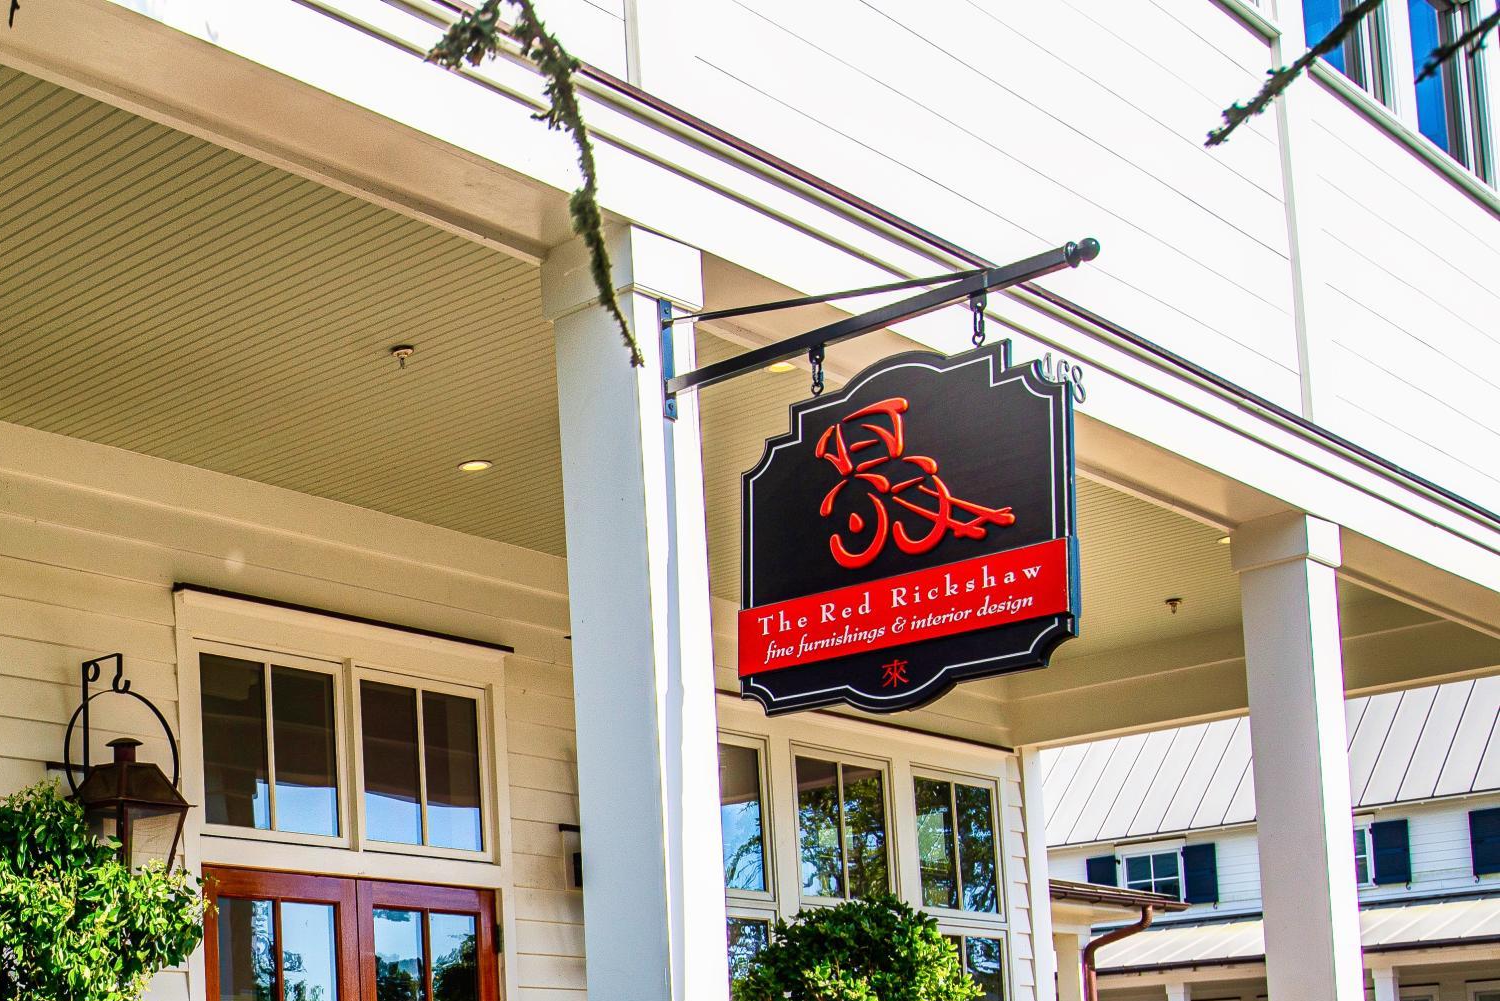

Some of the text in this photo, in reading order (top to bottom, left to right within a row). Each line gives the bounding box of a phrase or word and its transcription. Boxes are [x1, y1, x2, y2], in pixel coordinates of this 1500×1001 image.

[757, 564, 1042, 636] The Red Rickshaw
[764, 594, 1034, 664] fine furnishings & interior design
[881, 659, 909, 688] 來
